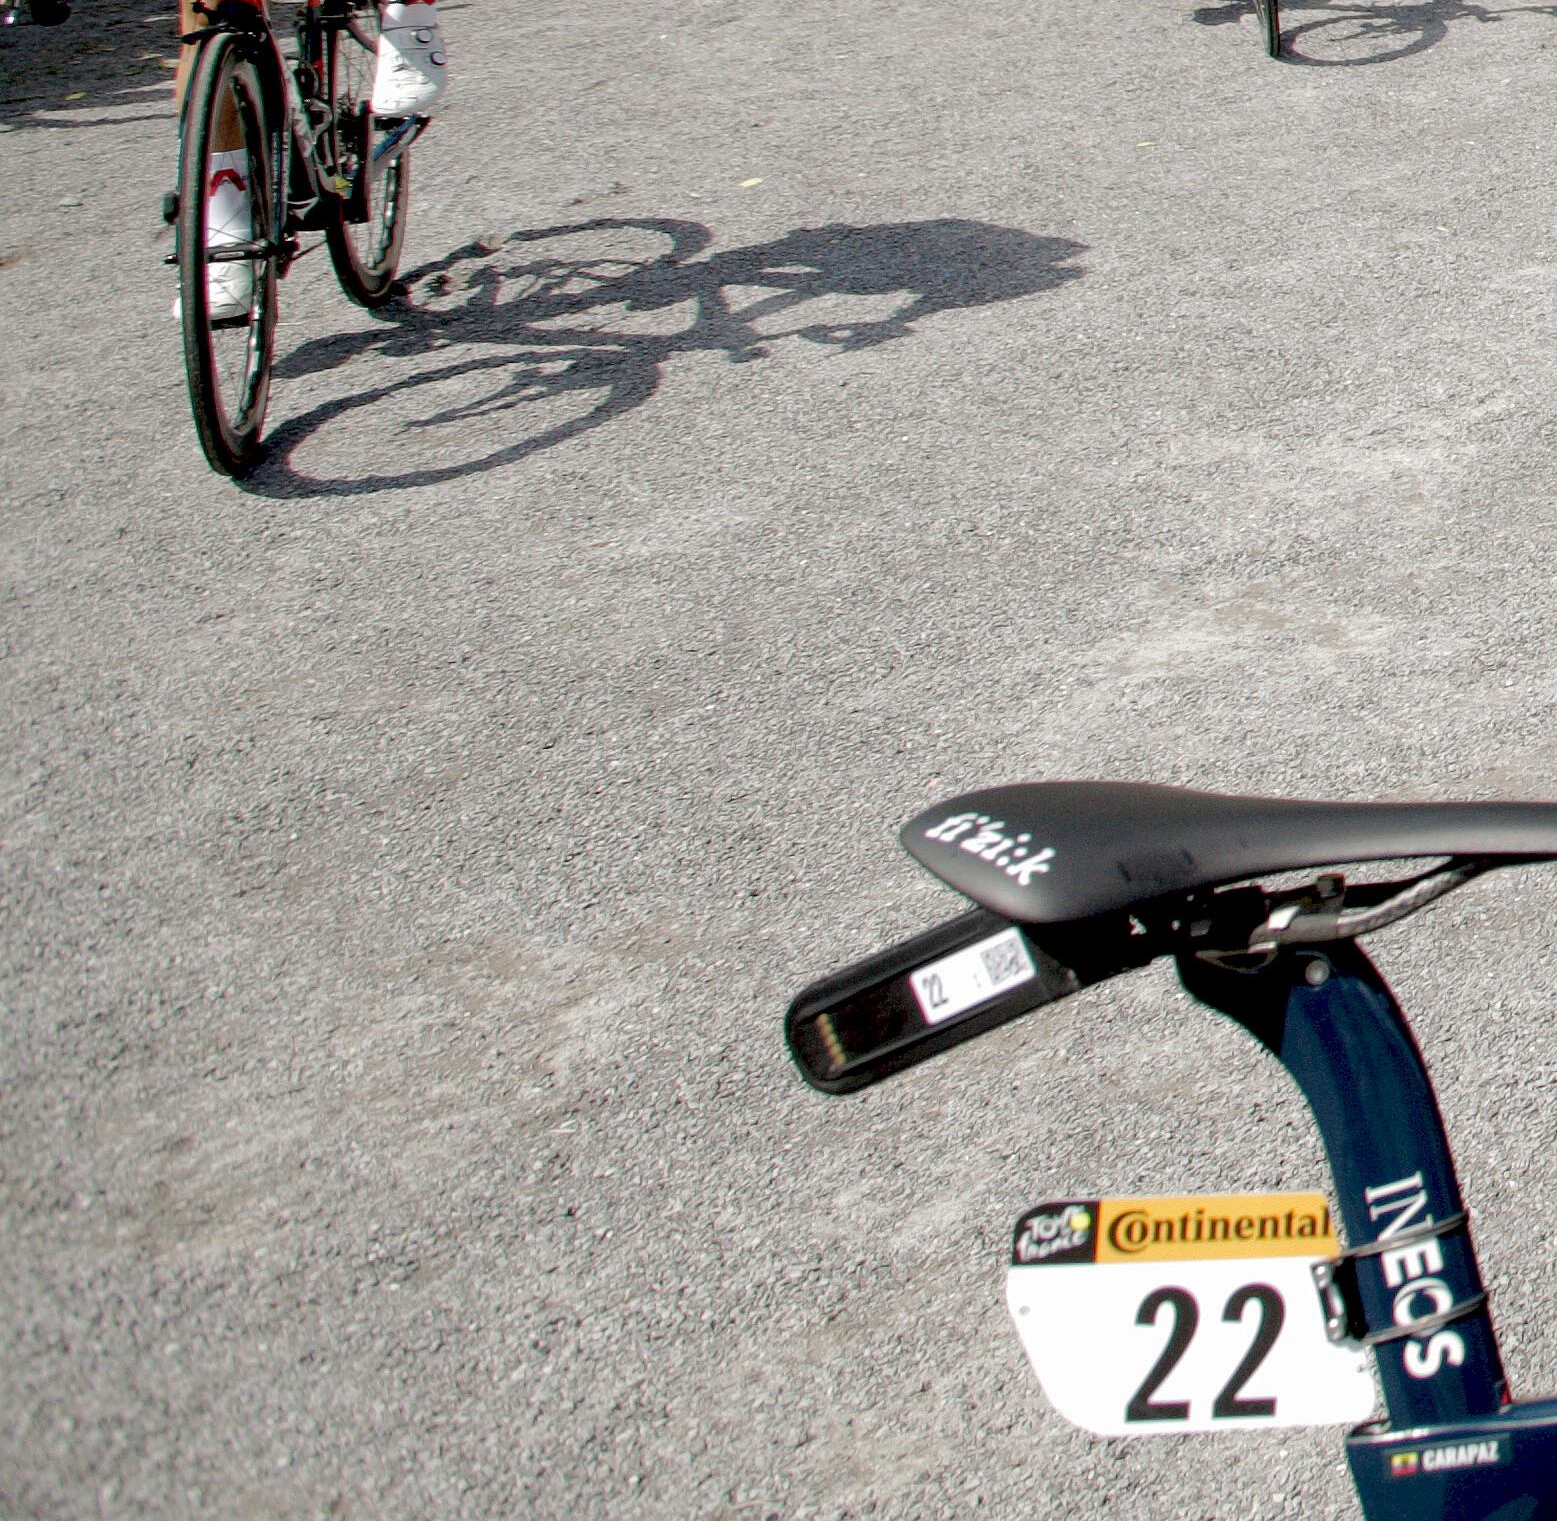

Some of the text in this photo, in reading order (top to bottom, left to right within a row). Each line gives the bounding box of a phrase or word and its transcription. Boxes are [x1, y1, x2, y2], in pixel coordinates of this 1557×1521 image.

[1107, 1207, 1331, 1255] Continental
[1364, 1169, 1465, 1379] INEOS
[1124, 1281, 1286, 1423] 22
[1421, 1441, 1500, 1472] CARAPAZ
